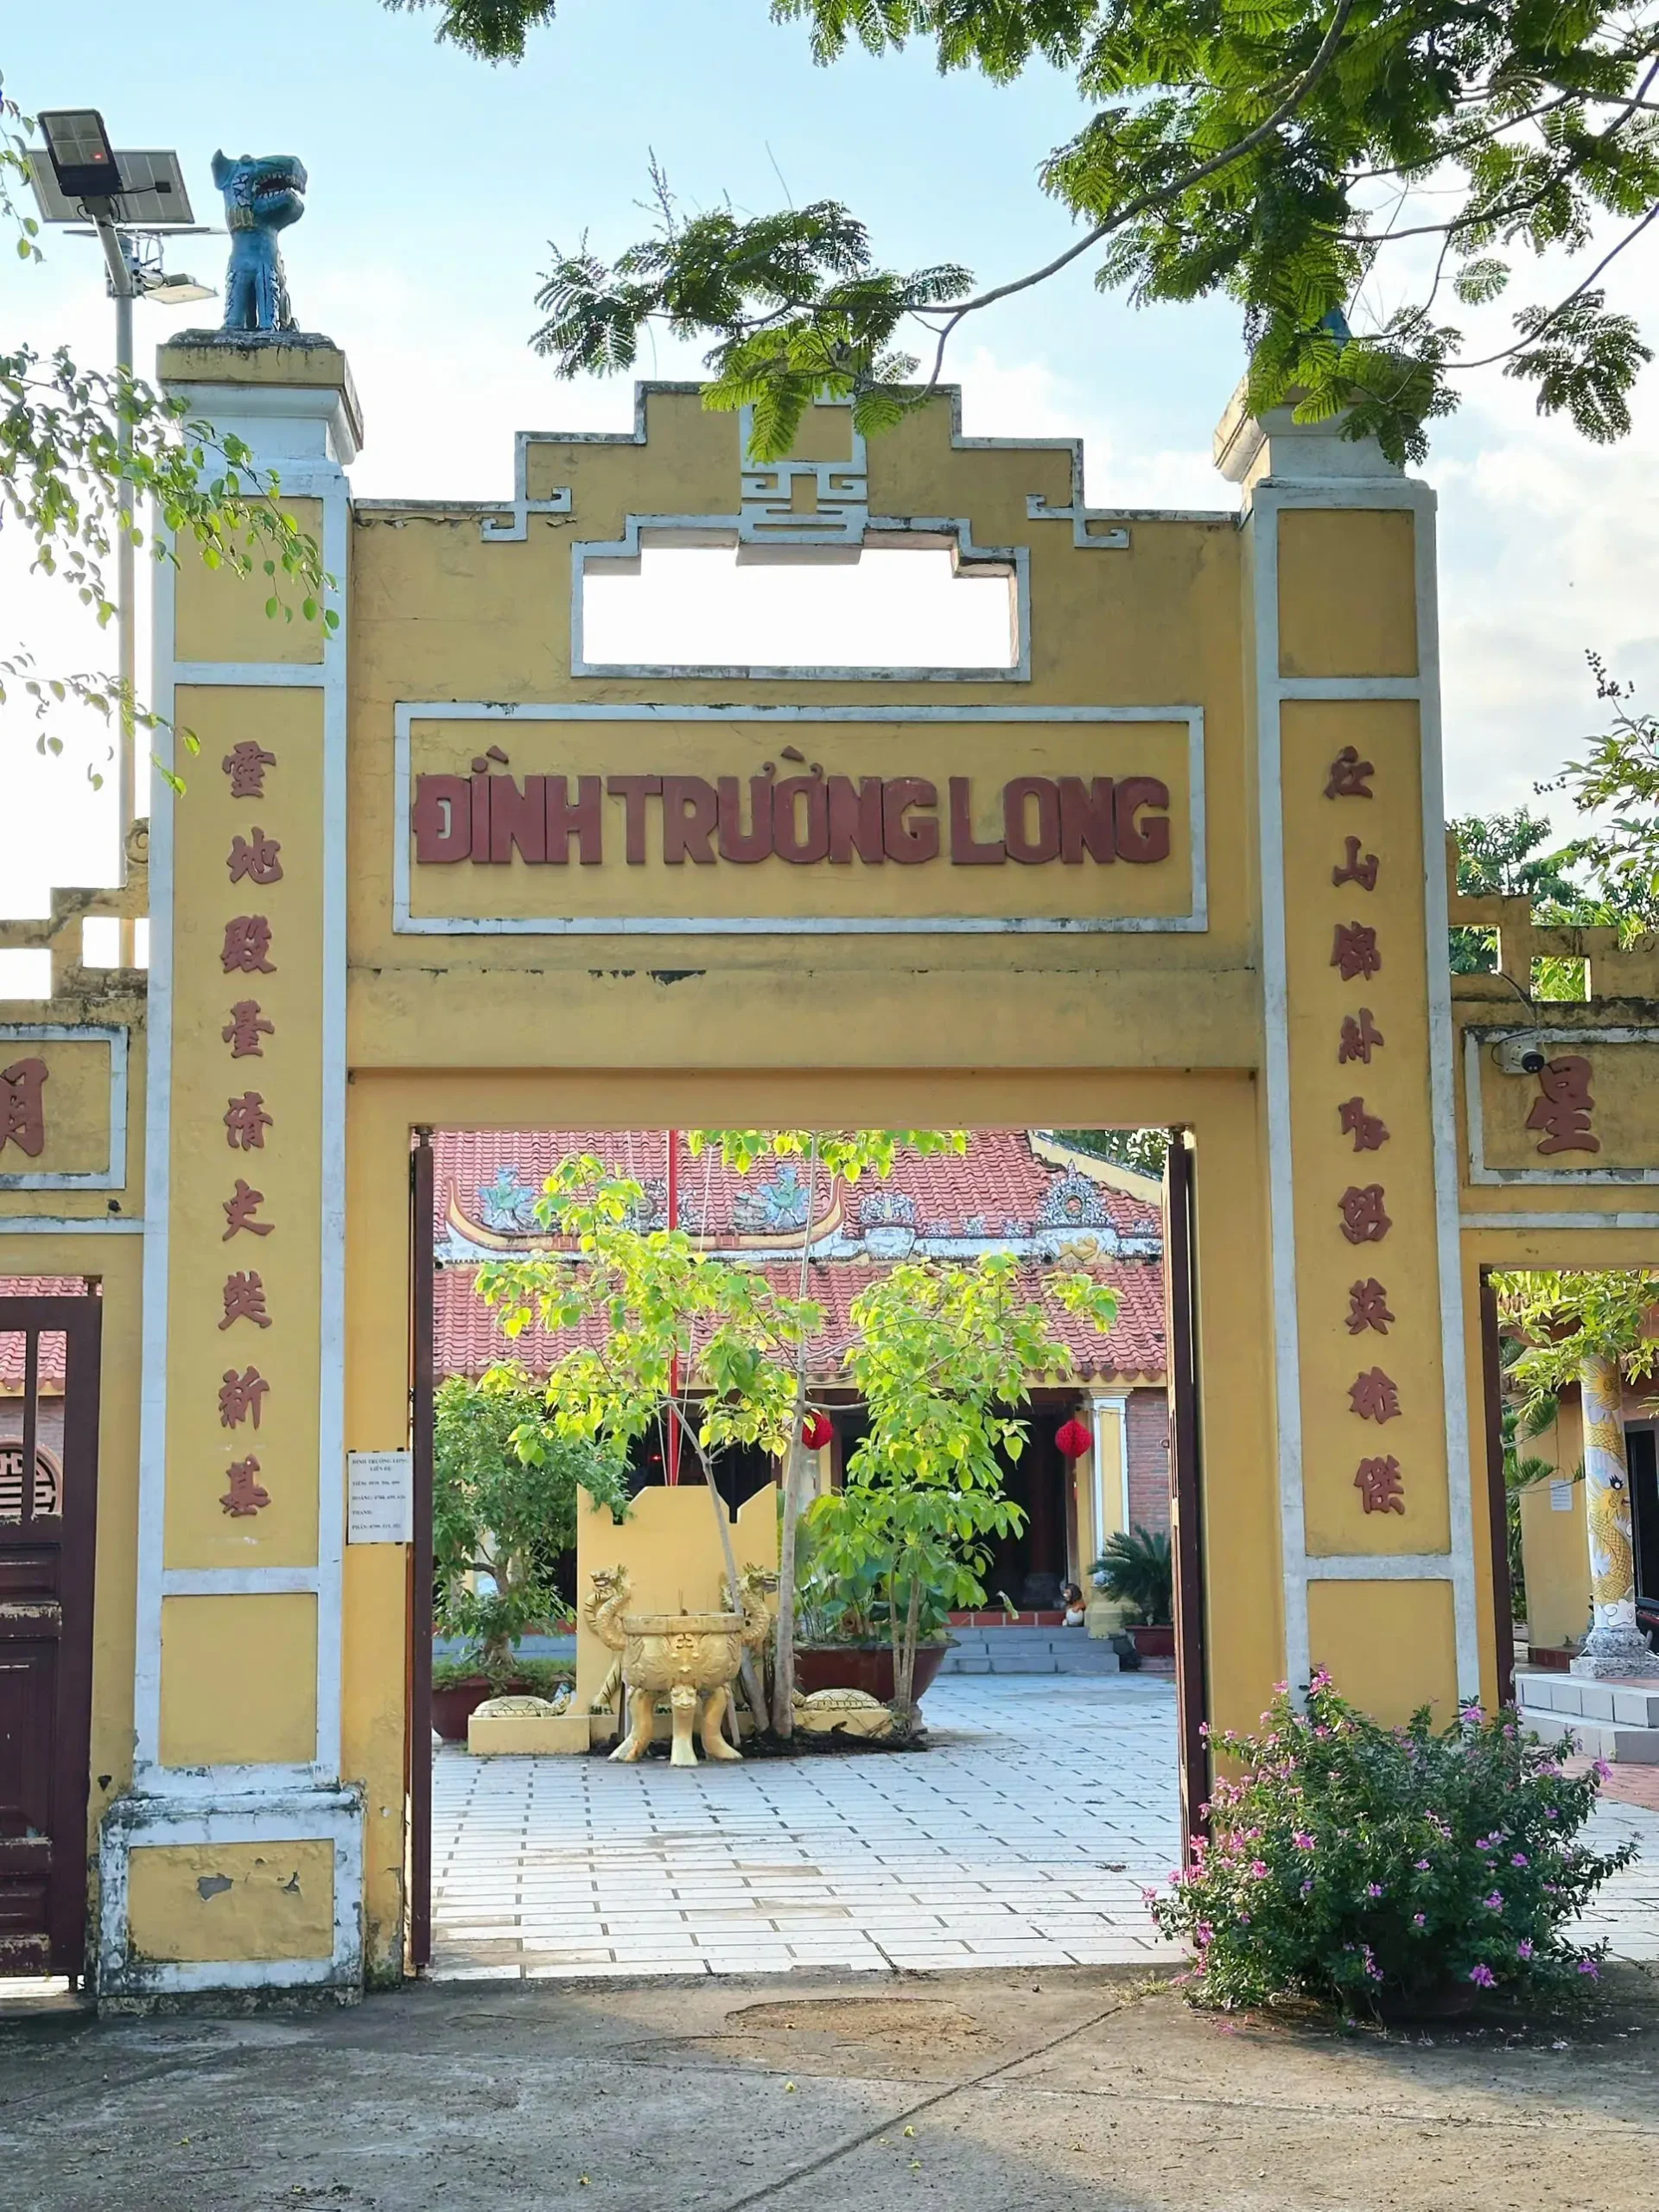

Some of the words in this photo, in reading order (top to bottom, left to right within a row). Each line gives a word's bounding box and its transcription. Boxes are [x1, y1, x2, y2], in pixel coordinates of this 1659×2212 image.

[413, 746, 602, 865] ĐÌNH
[607, 746, 940, 865] TRƯỜNG
[949, 774, 1170, 866] LONG
